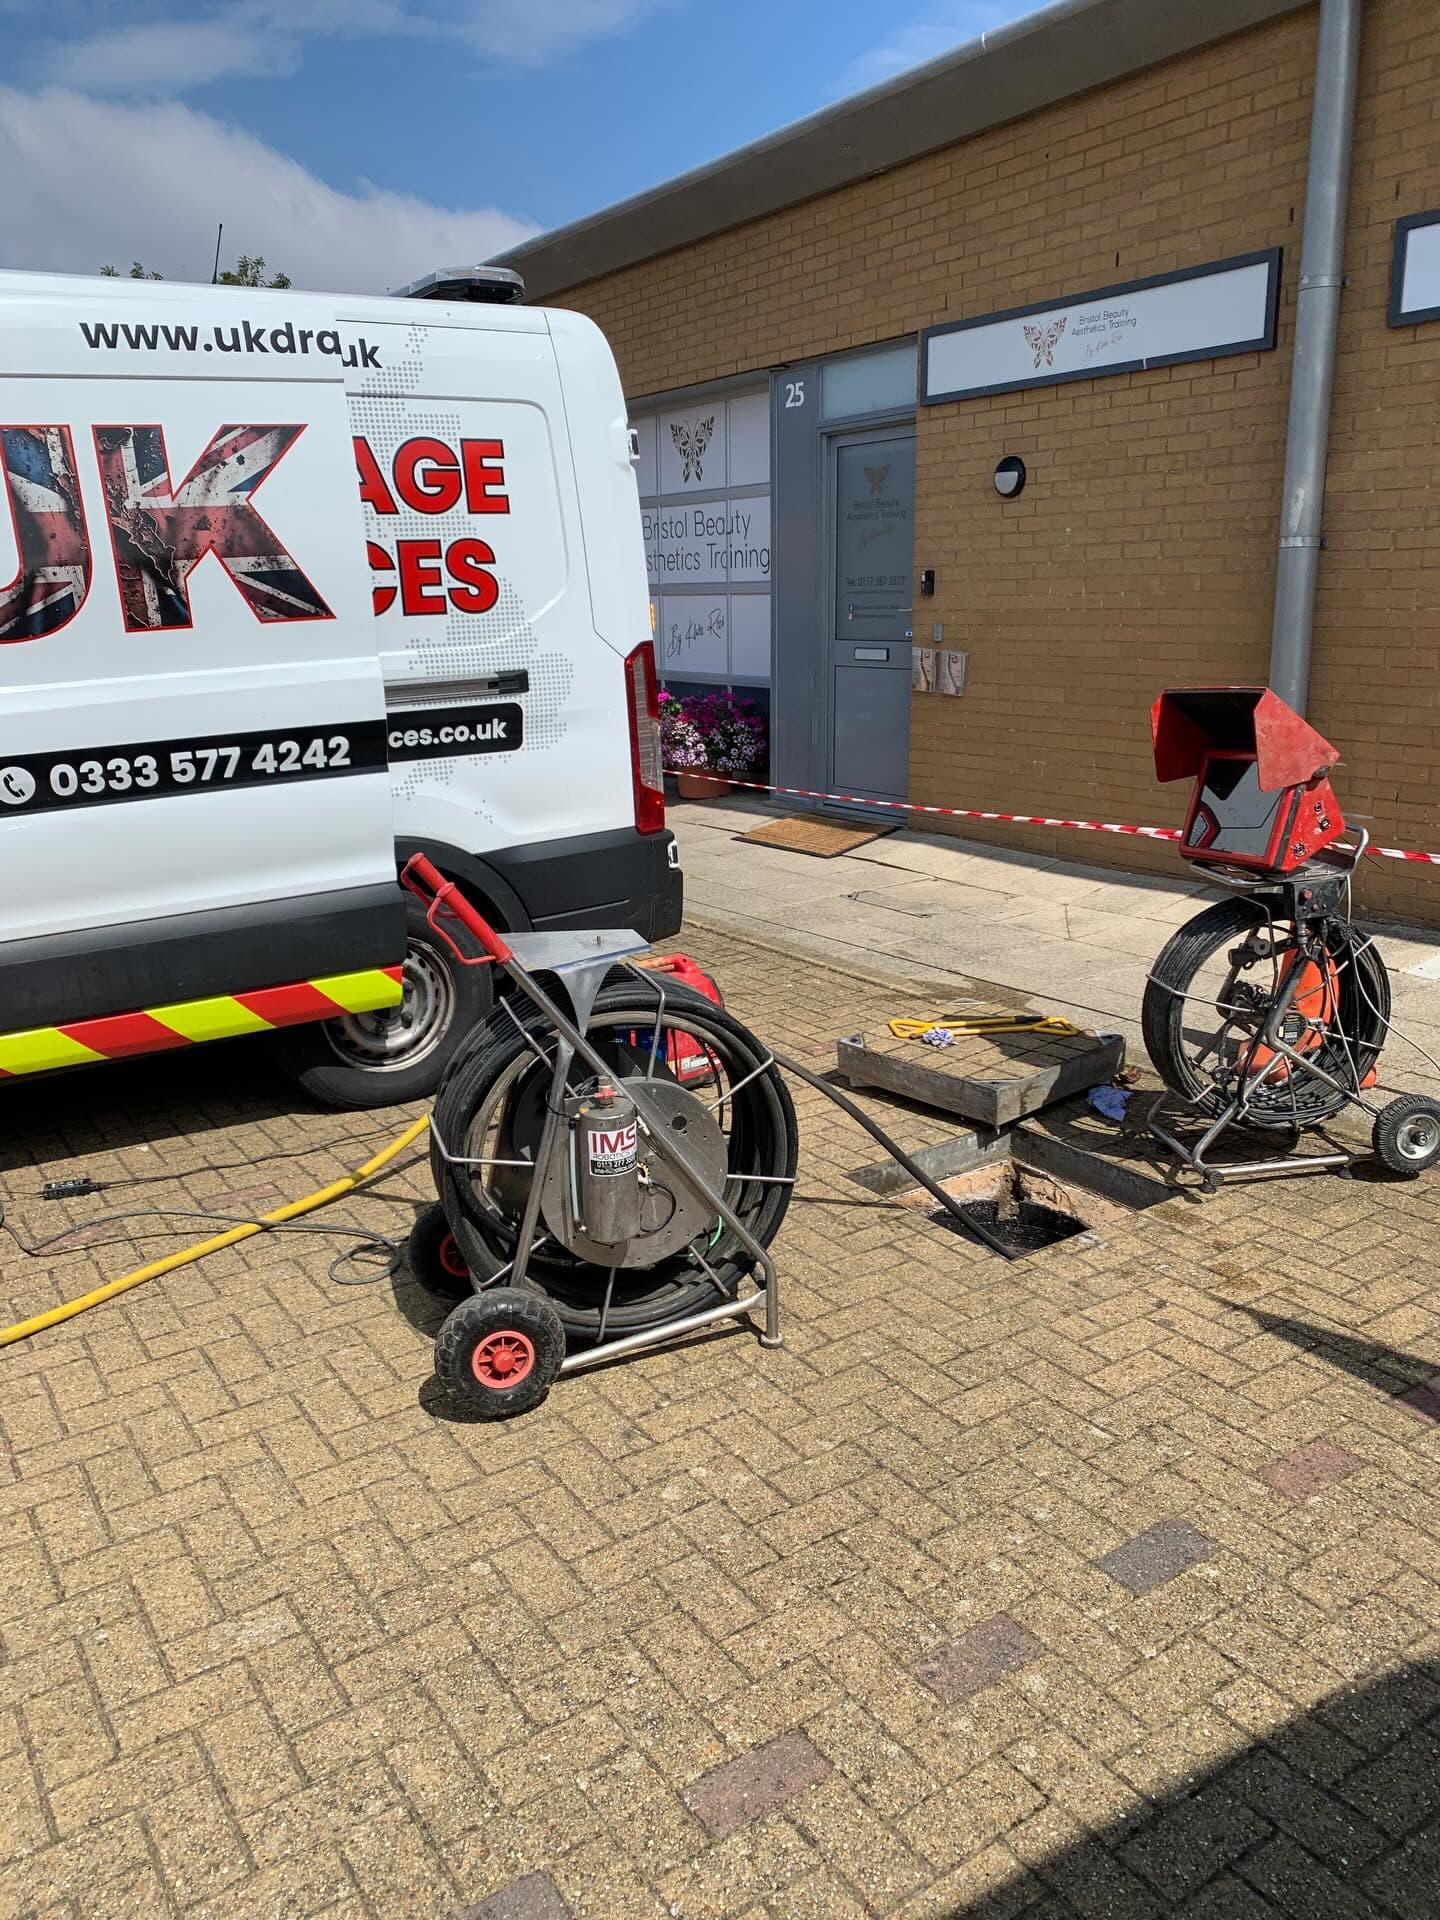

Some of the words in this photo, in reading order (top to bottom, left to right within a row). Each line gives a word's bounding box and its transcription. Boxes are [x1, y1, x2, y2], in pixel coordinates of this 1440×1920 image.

[1071, 324, 1106, 336] Aesthetics
[1108, 318, 1137, 328] Training
[1079, 313, 1102, 325] Bristol
[1103, 309, 1129, 320] Beauty
[79, 320, 342, 355] www.ukdra
[785, 381, 805, 409] 25
[642, 511, 688, 540] Bristol
[694, 508, 751, 540] Beauty
[706, 542, 770, 574] Training
[387, 718, 508, 748] ces.co.uk
[49, 755, 160, 797] 0333
[170, 747, 243, 784] 577
[251, 736, 351, 774] 4242
[592, 1125, 636, 1153] IMS
